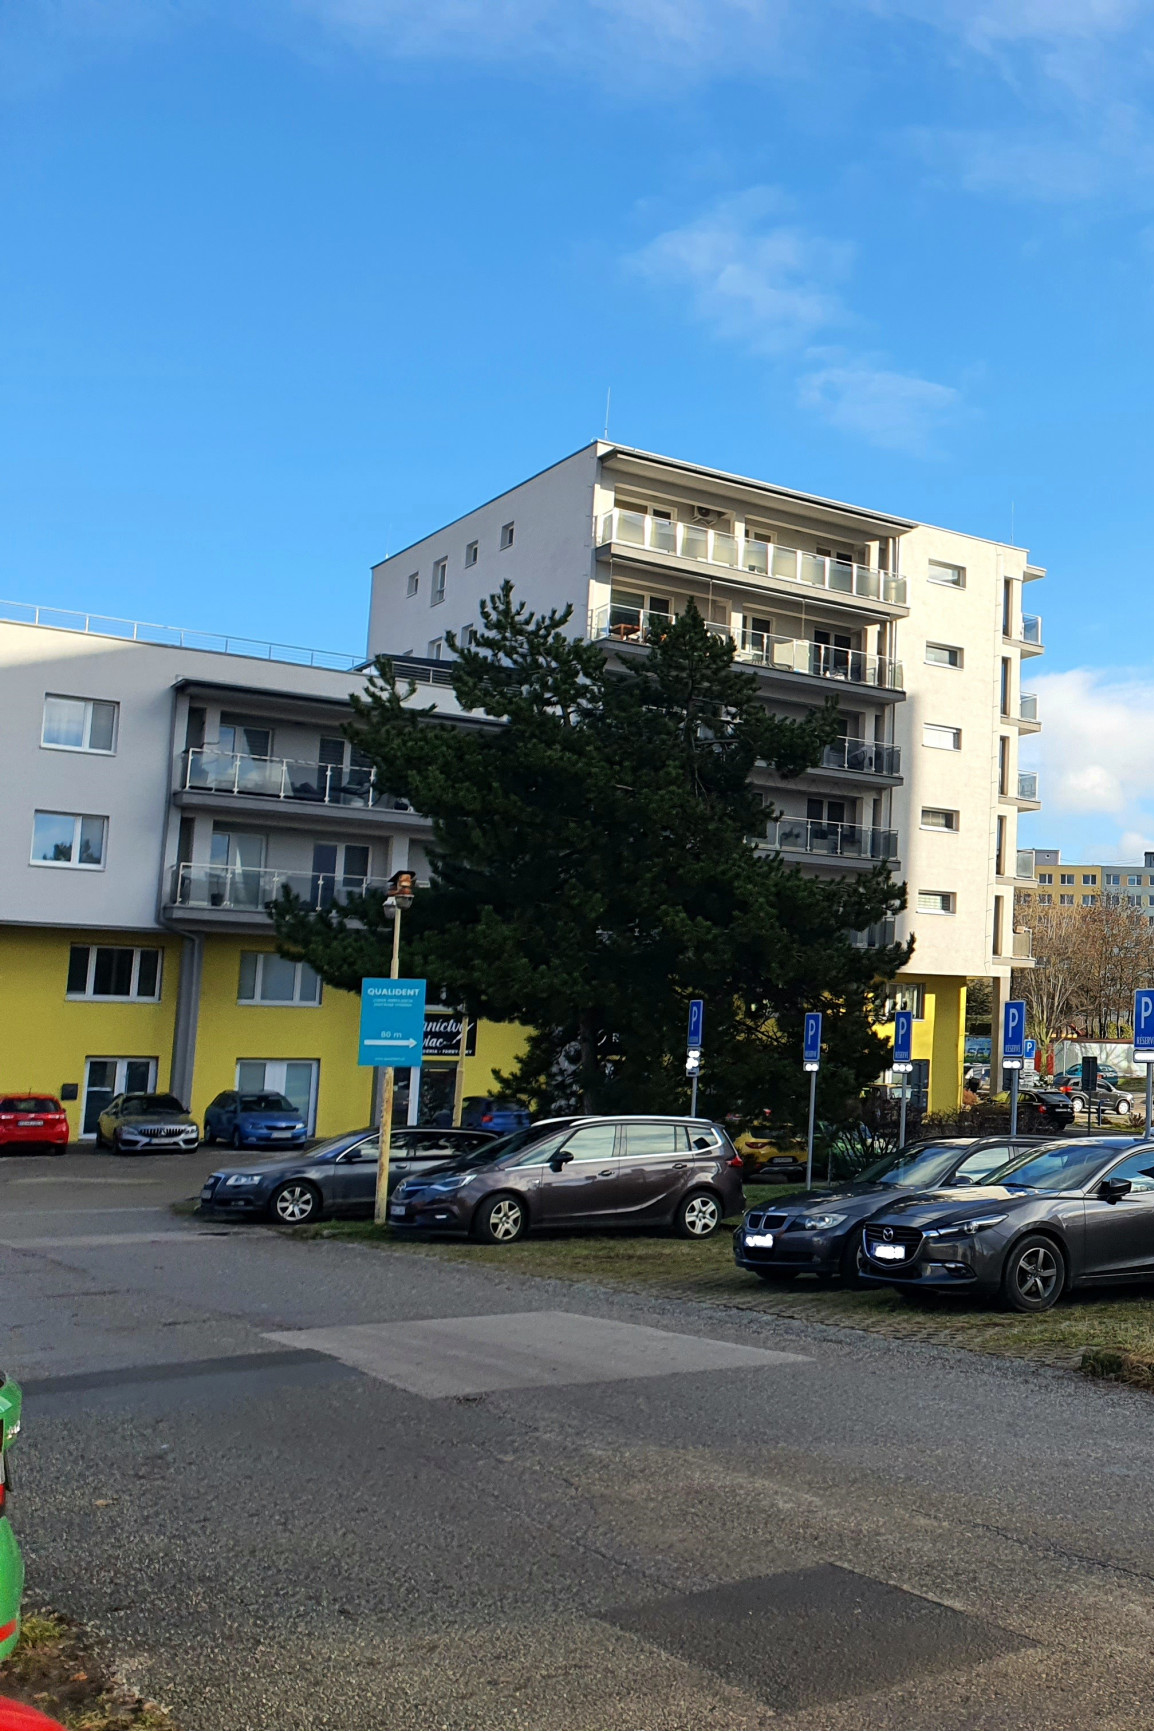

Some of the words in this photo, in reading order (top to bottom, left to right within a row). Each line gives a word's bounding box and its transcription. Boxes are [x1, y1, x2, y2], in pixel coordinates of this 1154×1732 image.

[367, 988, 420, 996] QUALIDENT
[1008, 1008, 1019, 1038] P
[1141, 996, 1153, 1029] P
